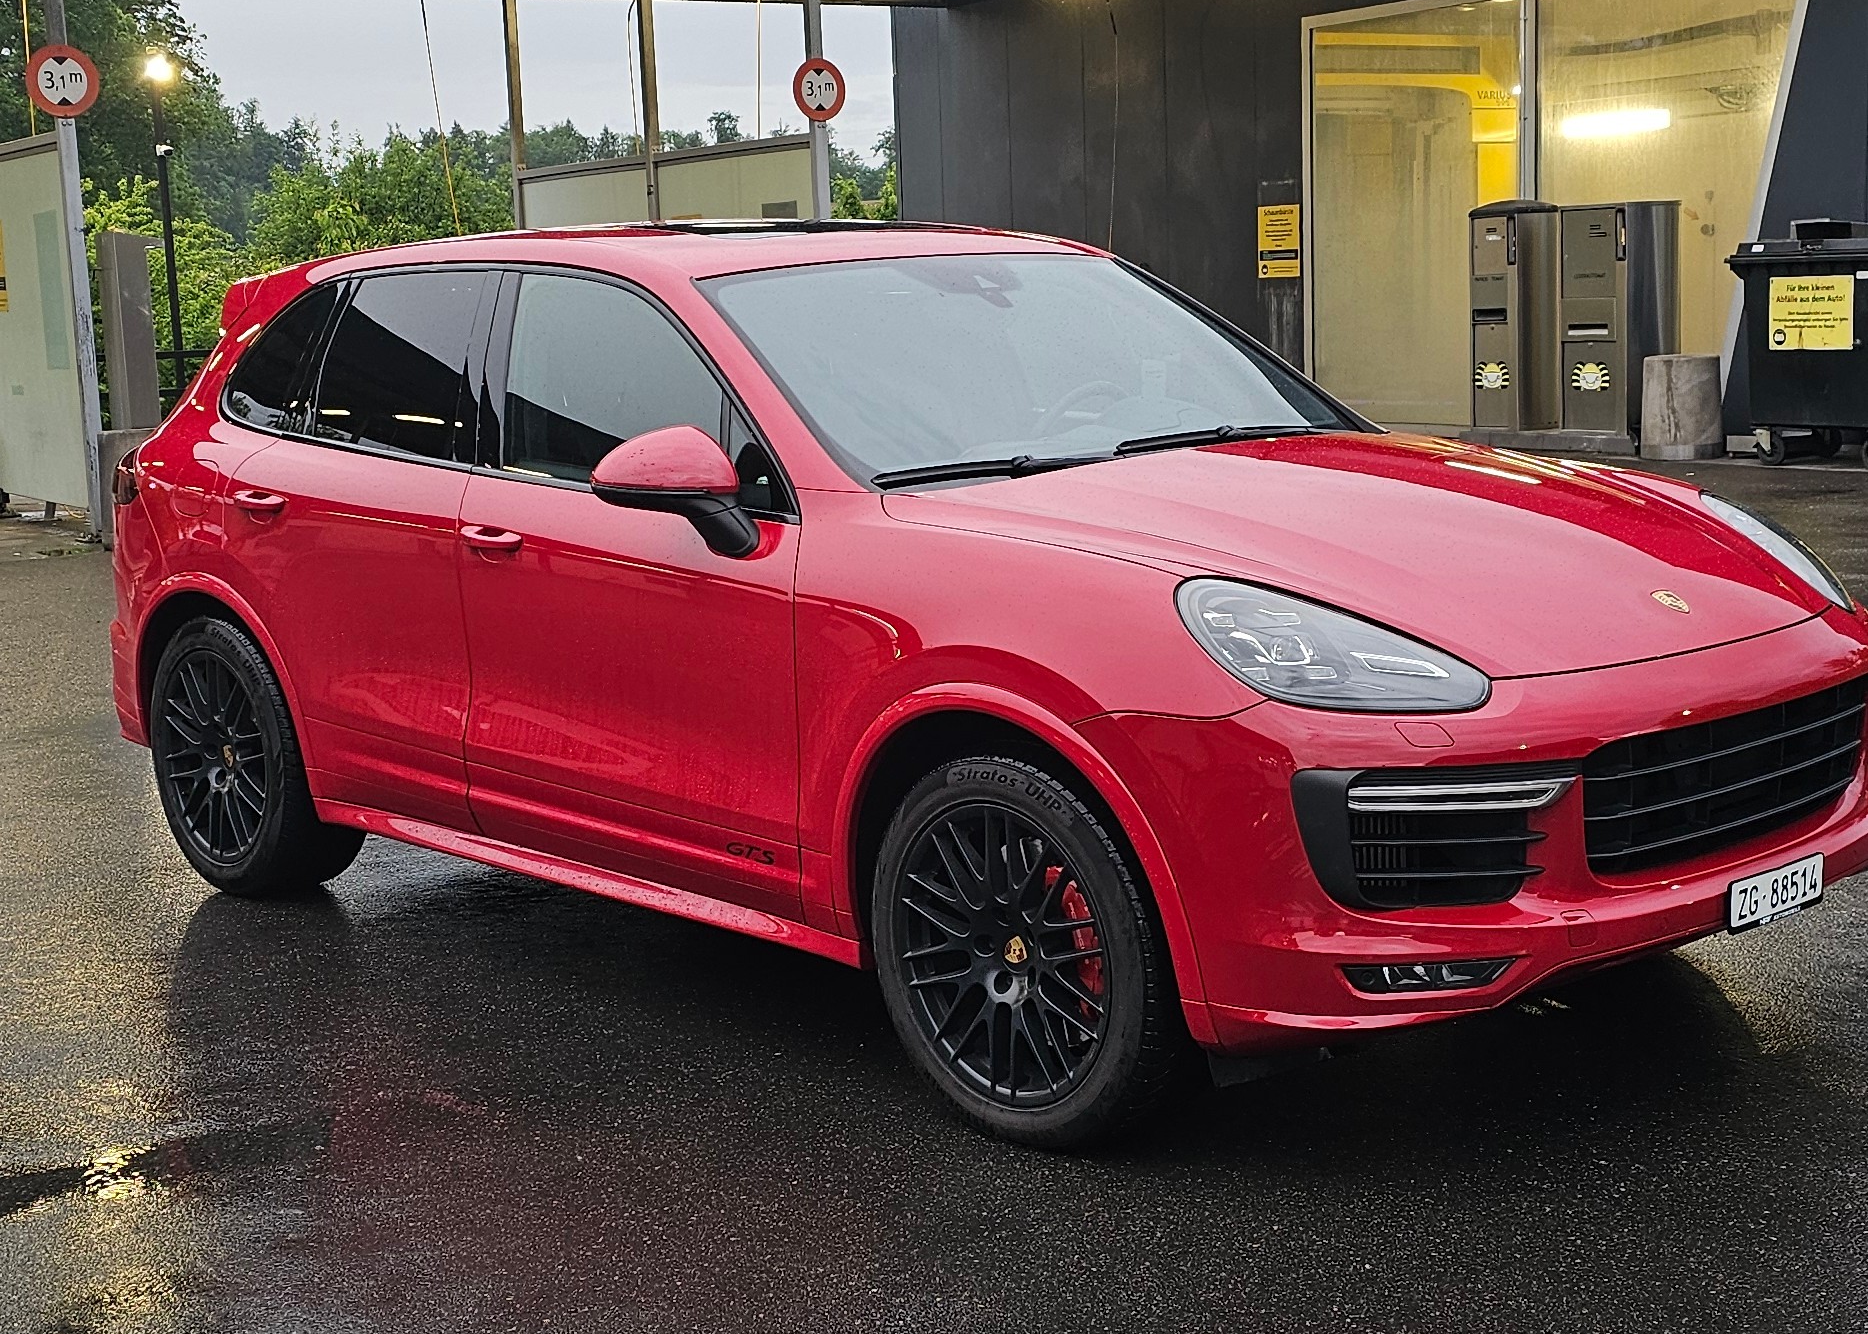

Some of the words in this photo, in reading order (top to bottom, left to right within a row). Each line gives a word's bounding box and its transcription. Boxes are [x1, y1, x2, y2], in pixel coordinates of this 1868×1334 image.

[1477, 90, 1512, 100] VARIUS
[1786, 284, 1797, 292] Für
[1798, 284, 1810, 292] Ihre
[1811, 283, 1835, 292] kleinen
[1776, 294, 1798, 303] Abfälle
[1811, 294, 1826, 303] dem
[1827, 294, 1845, 303] Auto!
[957, 768, 1018, 788] Stratos
[726, 841, 775, 866] GTS
